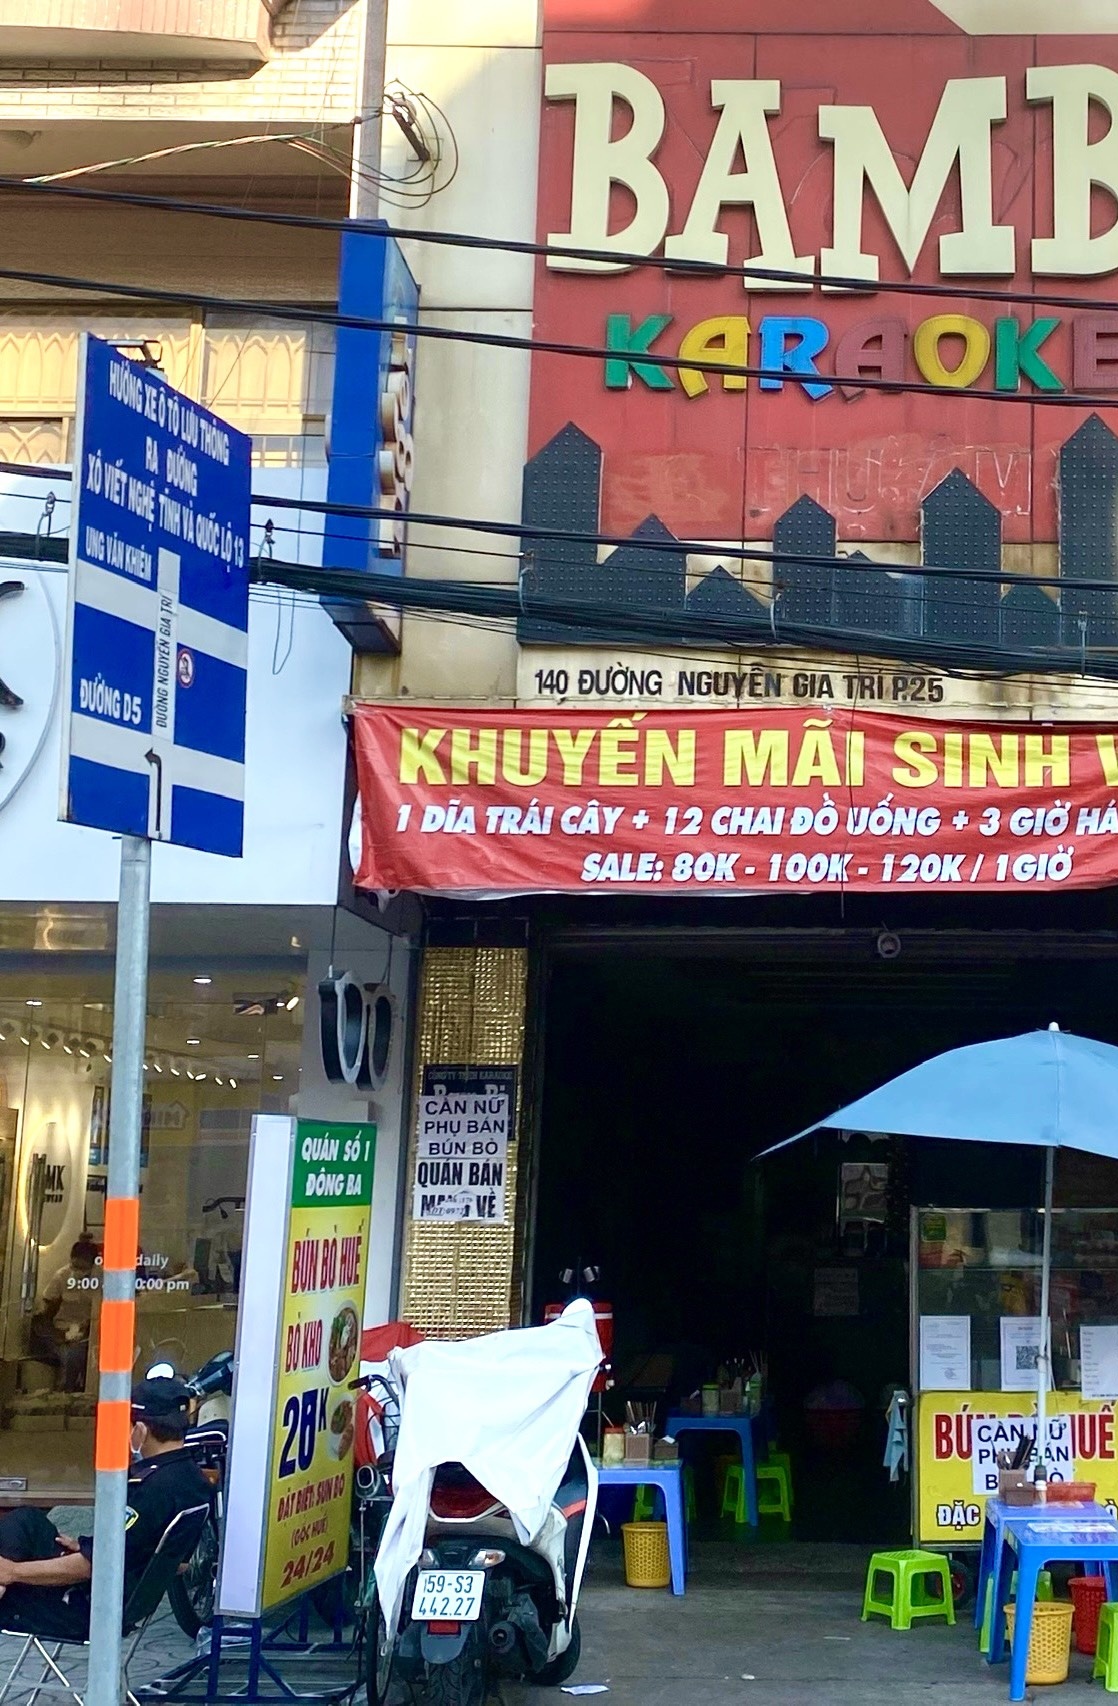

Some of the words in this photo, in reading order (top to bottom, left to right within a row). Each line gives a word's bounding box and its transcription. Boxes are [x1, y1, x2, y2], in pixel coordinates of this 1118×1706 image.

[144, 383, 157, 422] XE
[158, 386, 166, 428] Ô
[167, 396, 180, 437] TÔ
[200, 418, 230, 466] THÔNG
[145, 436, 159, 475] RA
[86, 449, 103, 494] XÔ
[104, 458, 128, 507] VIẾT
[128, 480, 156, 532] NGHỆ
[182, 500, 195, 544] VÀ
[196, 512, 220, 556] QUỐC
[220, 521, 232, 573] LỘ
[233, 535, 245, 569] 13
[125, 544, 152, 582] KHIÊM
[159, 617, 172, 638] GIA
[534, 669, 568, 695] 140
[577, 661, 663, 695] ĐƯỜNG
[792, 672, 834, 699] GIA
[892, 674, 944, 703] P.25
[79, 672, 121, 719] ĐƯỜNG
[123, 693, 142, 725] D5
[400, 712, 697, 786] KHUYẾN
[723, 718, 864, 787] MÃI
[892, 729, 1070, 788] SINH
[397, 805, 409, 832] 1
[485, 797, 553, 834] TRÁI
[561, 800, 624, 835] CÂY
[632, 811, 650, 829] +
[664, 806, 702, 835] 12
[711, 806, 783, 835] CHAI
[789, 792, 839, 836] ĐỒ
[847, 793, 942, 836] UỐNG
[952, 812, 970, 831] +
[979, 807, 1001, 836] 3
[1010, 799, 1073, 836] GIỜ
[581, 852, 664, 882] SALE:
[672, 852, 742, 882] 80K
[769, 852, 852, 882] 100K
[881, 853, 967, 883] 120K
[474, 1096, 505, 1115] NỮ
[424, 1120, 461, 1137] PHỤ
[467, 1117, 505, 1134] BÁN
[301, 1132, 340, 1163] QUÁN
[343, 1130, 363, 1162] SỐ
[364, 1140, 371, 1162] 1
[428, 1138, 467, 1155] BÚN
[472, 1138, 499, 1155] BÒ
[305, 1167, 345, 1196] ĐÔNG
[345, 1173, 362, 1196] BA
[417, 1158, 463, 1187] QUÁN
[468, 1159, 503, 1186] BÁN
[476, 1188, 497, 1218] VỀ
[136, 1253, 169, 1269] daily
[291, 1228, 320, 1294] BÚN
[320, 1225, 338, 1290] BÒ
[339, 1218, 365, 1287] HUẾ
[67, 1277, 99, 1290] 9:00
[134, 1277, 163, 1290] 0:00
[166, 1280, 190, 1293] pm
[285, 1311, 301, 1373] BÒ
[301, 1319, 323, 1369] KHO
[934, 1404, 972, 1460] BÚ
[936, 1500, 981, 1531] ĐẶC
[280, 1540, 336, 1589] 24/24
[426, 1575, 474, 1594] 59-S3
[418, 1597, 476, 1617] 442.27
